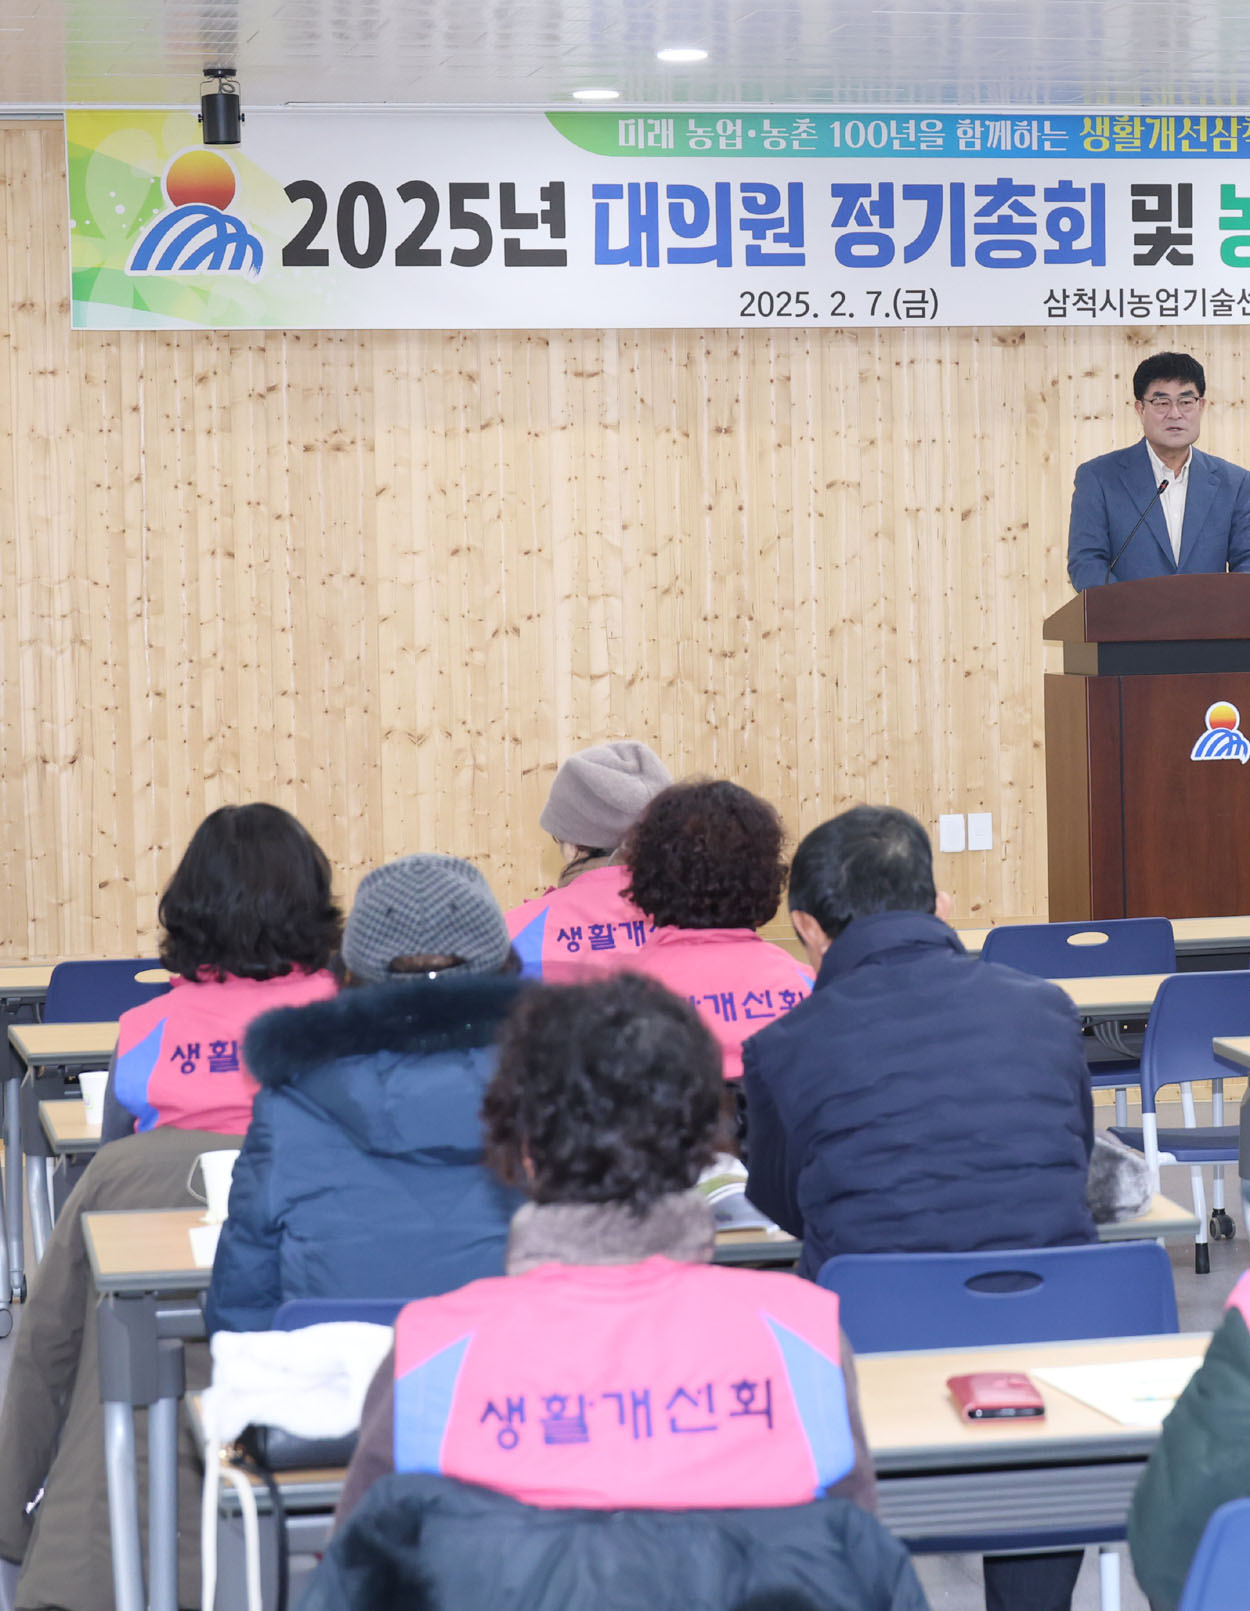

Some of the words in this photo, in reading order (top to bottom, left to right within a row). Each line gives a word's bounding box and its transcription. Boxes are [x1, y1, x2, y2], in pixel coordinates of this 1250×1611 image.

[618, 119, 674, 149] 미래
[686, 118, 818, 150] 농업·농촌
[829, 119, 945, 150] 100년을
[956, 119, 1069, 151] 함께하는
[282, 180, 567, 268] 2025년
[592, 181, 806, 267] 대의원
[830, 177, 1106, 268] 정기총회
[1131, 182, 1194, 266] 및
[739, 291, 818, 318] 2025.
[830, 291, 854, 318] 2.
[866, 288, 938, 320] 7.(금)
[557, 920, 656, 953] 생활개
[690, 989, 803, 1022] 개선회
[480, 1379, 774, 1450] 생활개선회
